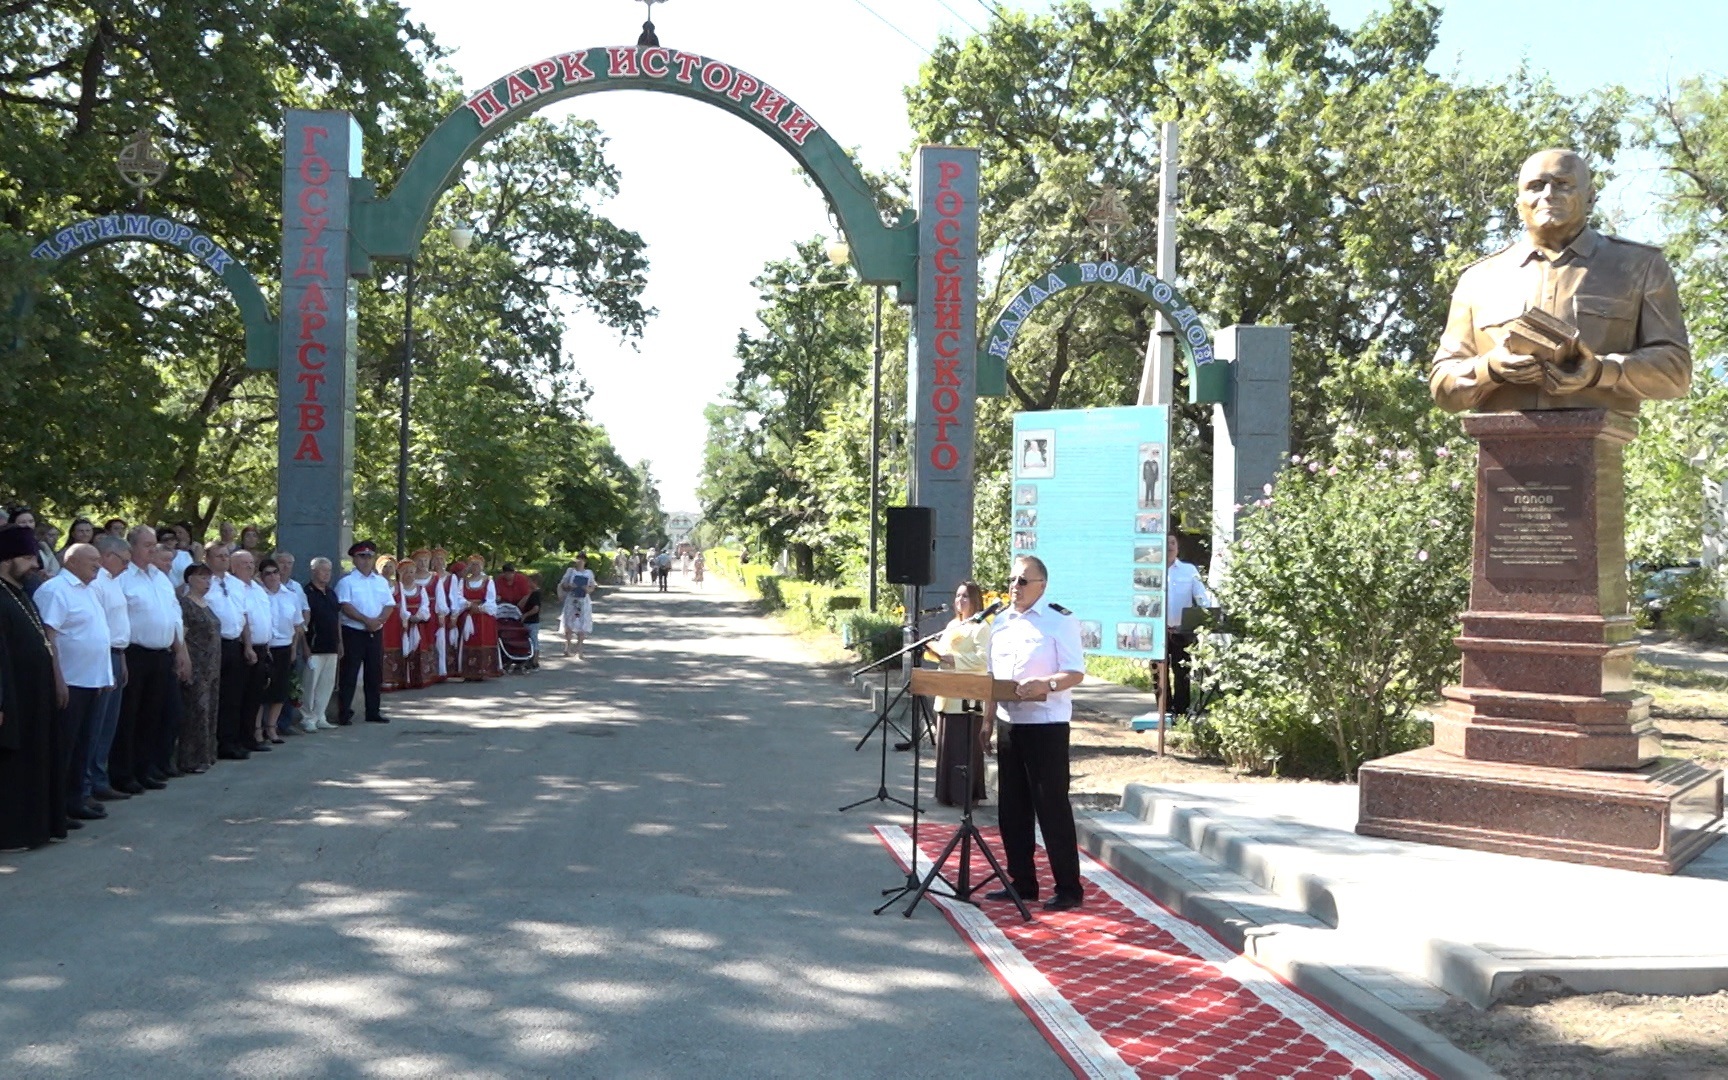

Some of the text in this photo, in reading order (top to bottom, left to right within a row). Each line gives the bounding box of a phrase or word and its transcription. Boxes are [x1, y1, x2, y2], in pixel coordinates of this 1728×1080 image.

[467, 47, 817, 144] ПАРК ИСТОРИИ
[293, 126, 331, 462] ГОСУДАРСТВА
[1079, 262, 1215, 367] ВОЛГО-ДОН
